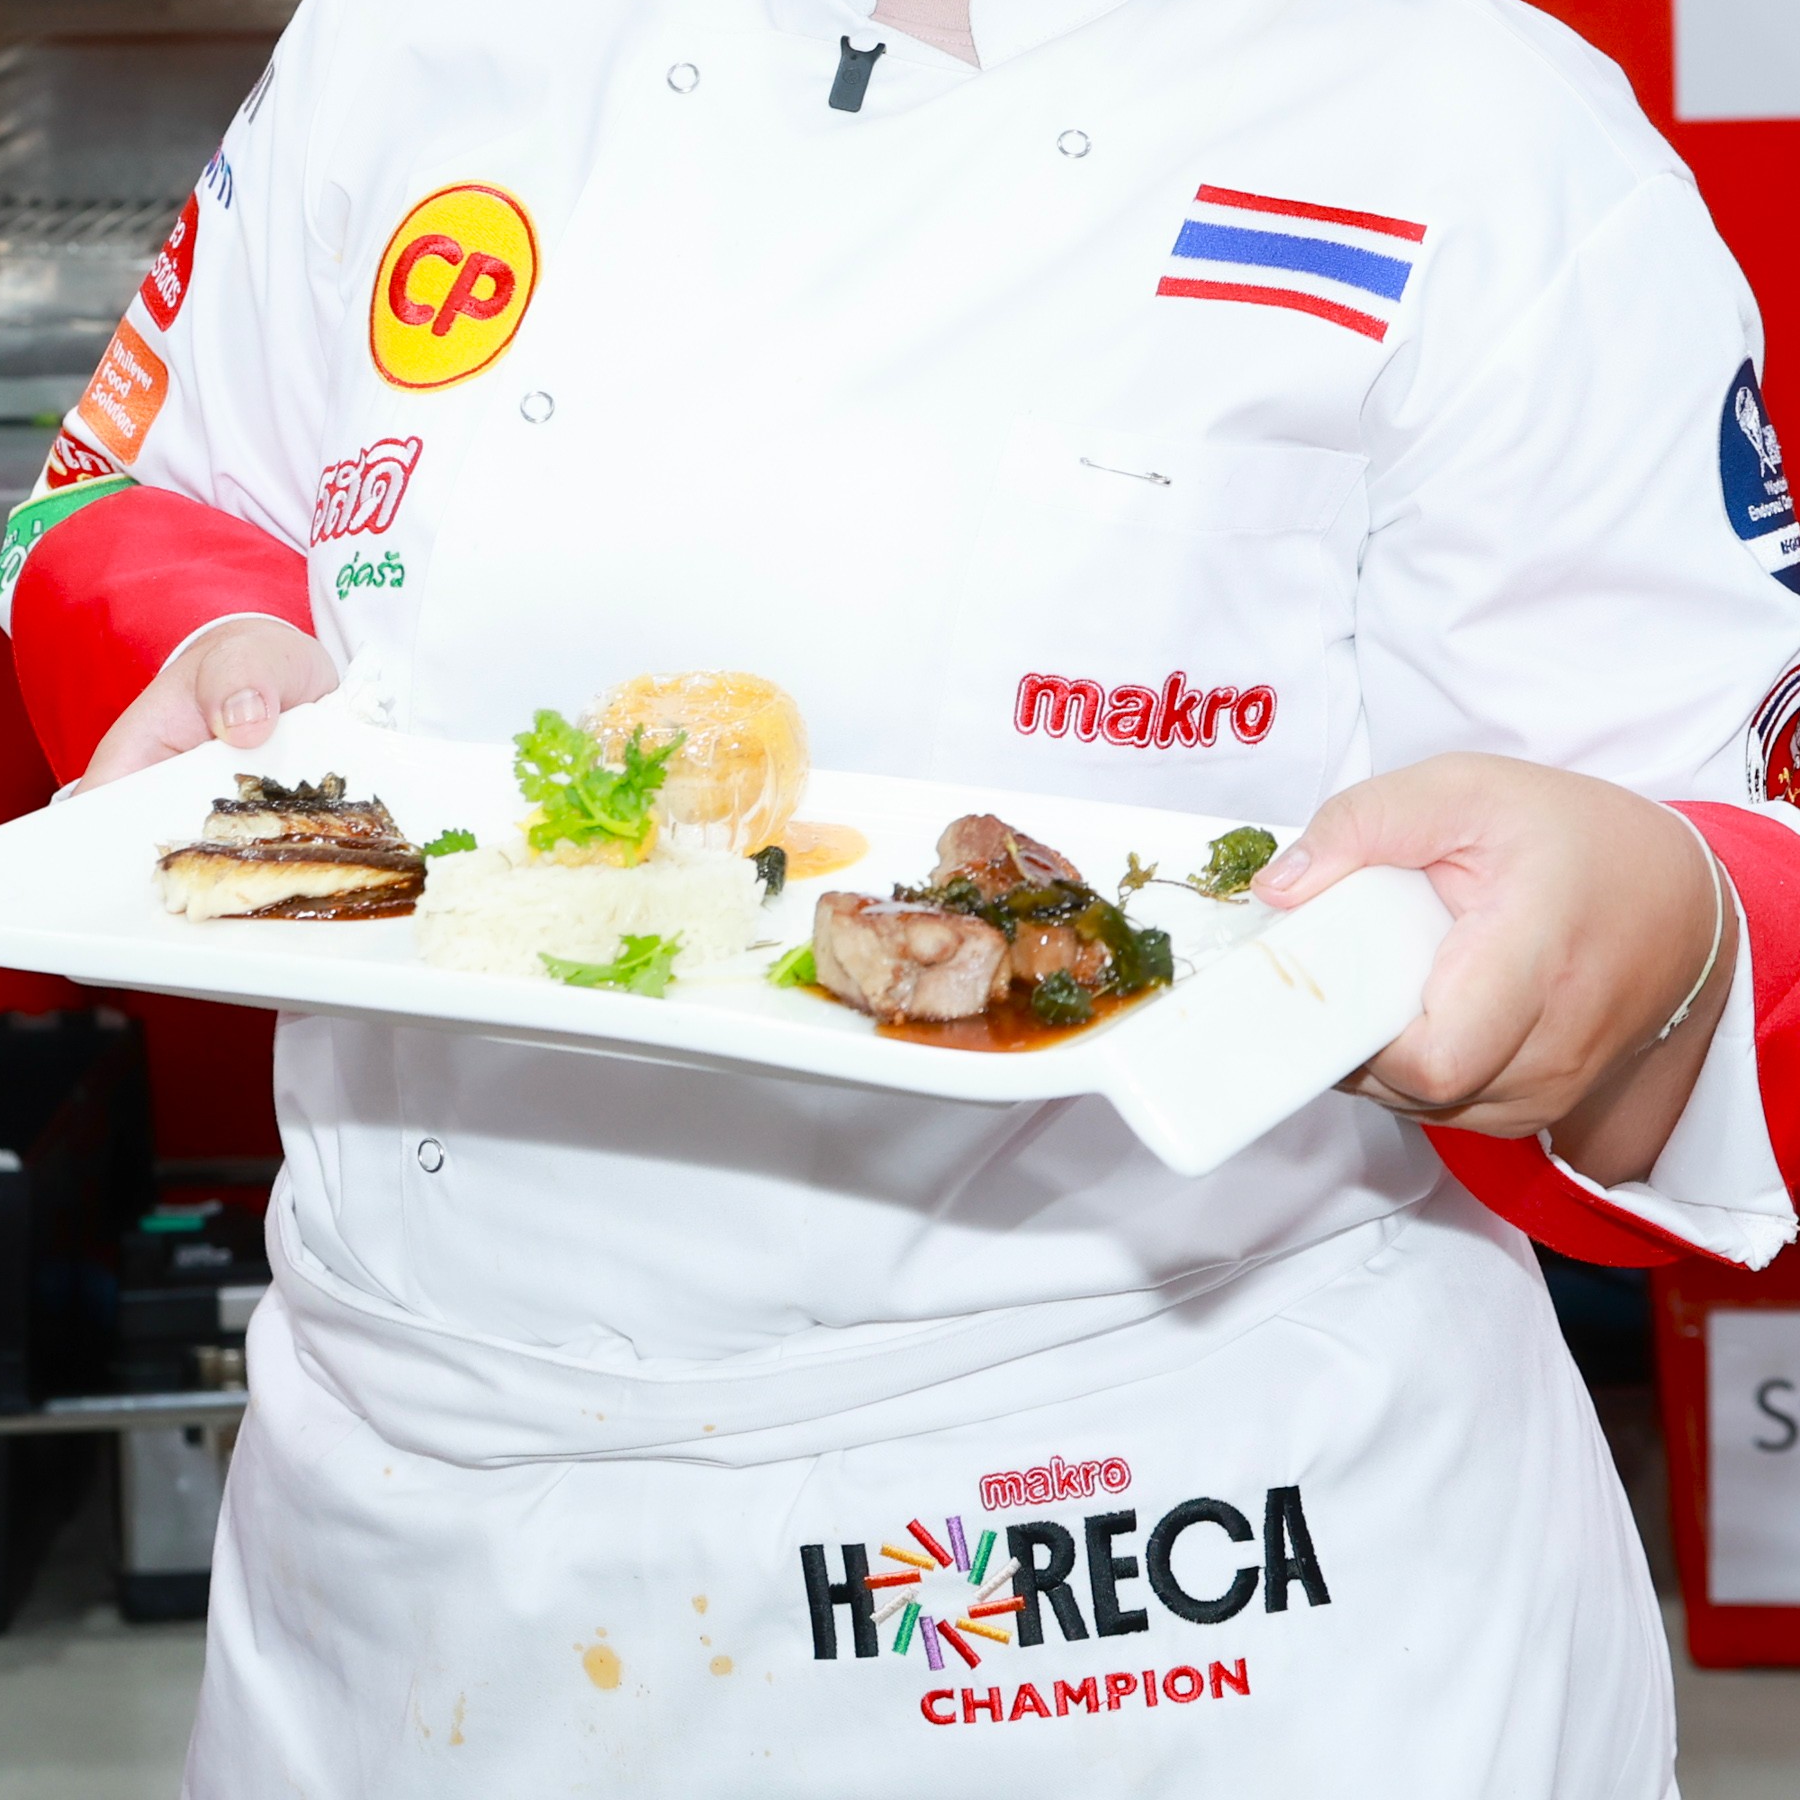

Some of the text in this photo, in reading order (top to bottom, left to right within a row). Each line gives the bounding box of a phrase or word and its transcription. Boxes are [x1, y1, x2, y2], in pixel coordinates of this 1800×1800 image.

[388, 234, 516, 337] CP
[102, 361, 132, 398] Food
[113, 339, 153, 391] Unilever
[91, 383, 136, 438] Solutions
[1014, 670, 1277, 749] makro
[980, 1455, 1131, 1511] makro
[921, 1656, 1251, 1725] CHAMPION
